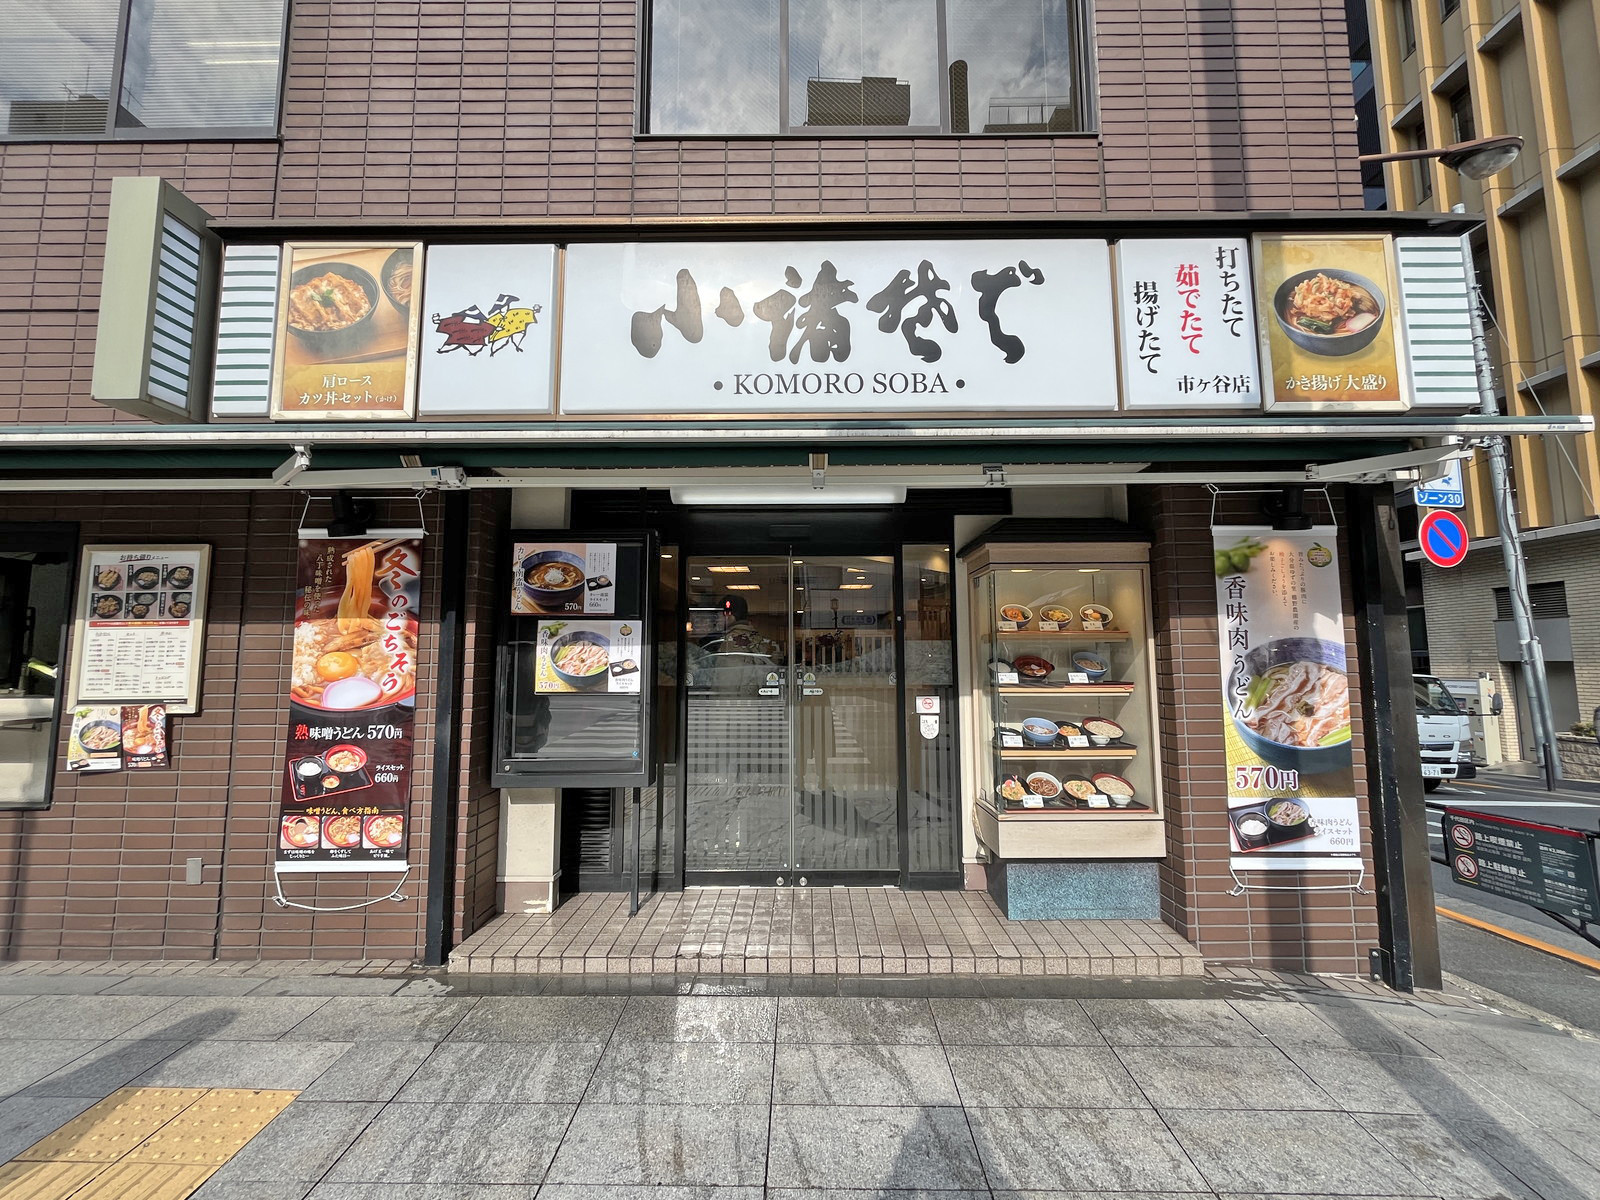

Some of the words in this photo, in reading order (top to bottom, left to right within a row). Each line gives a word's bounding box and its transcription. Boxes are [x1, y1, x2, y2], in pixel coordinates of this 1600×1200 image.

[1215, 246, 1244, 338] 打ちたて
[1173, 263, 1204, 355] 茹でたて
[1132, 280, 1162, 374] 揚げたて
[322, 373, 372, 388] 肩ロース
[733, 372, 864, 395] KOMORO
[872, 372, 949, 395] SOBA
[375, 547, 418, 692] 冬のごちそう
[1224, 575, 1252, 720] 香味肉うどん
[367, 724, 403, 740] 570円
[374, 772, 399, 783] 660円
[1236, 766, 1298, 790] 570円
[1329, 837, 1354, 846] 660円
